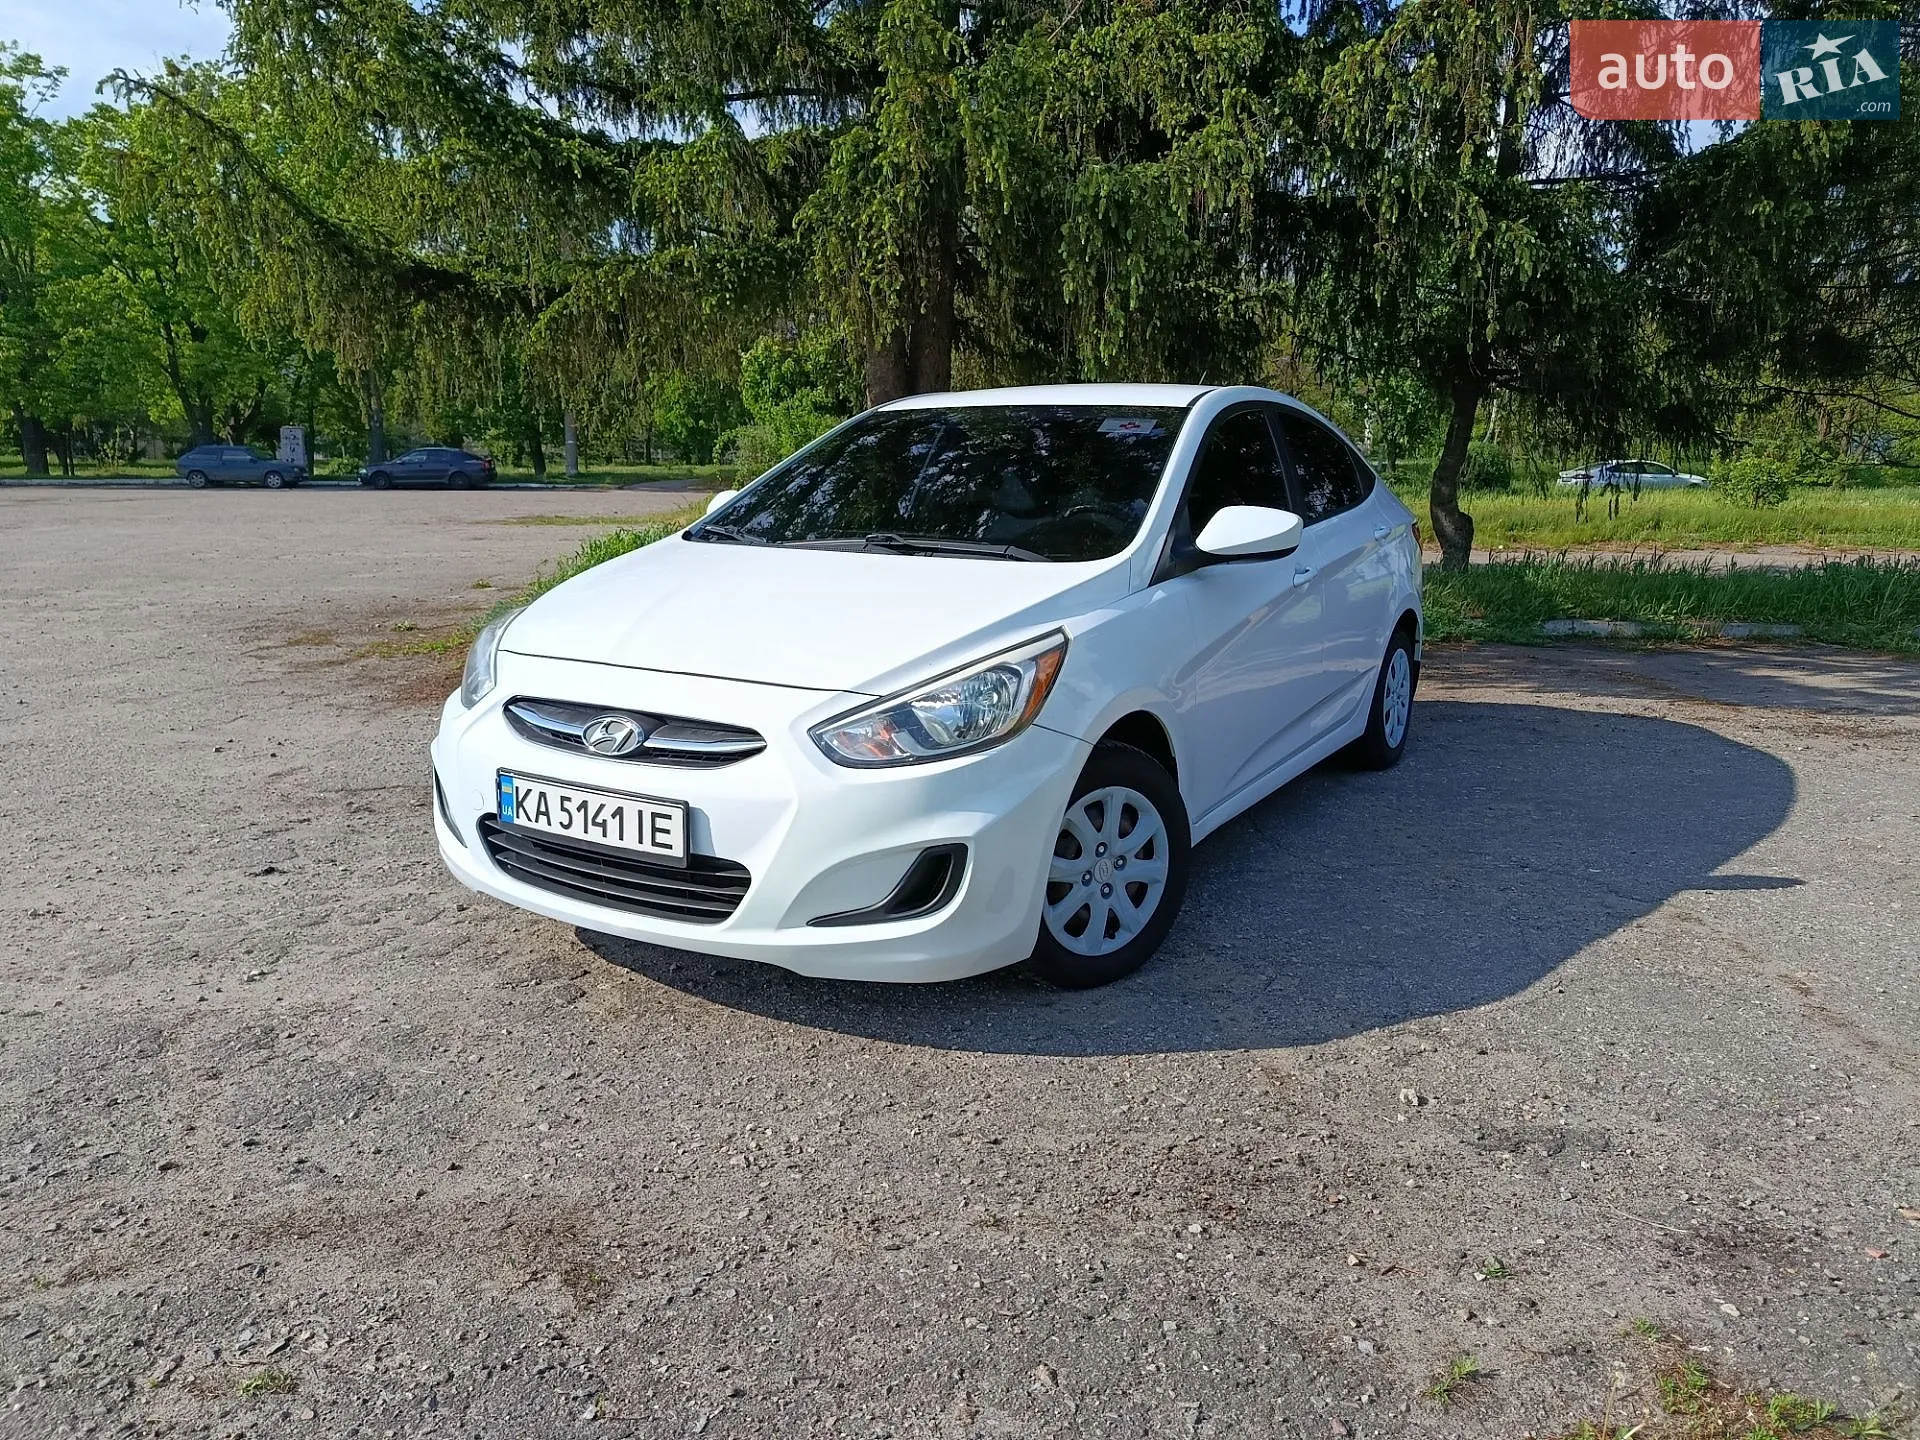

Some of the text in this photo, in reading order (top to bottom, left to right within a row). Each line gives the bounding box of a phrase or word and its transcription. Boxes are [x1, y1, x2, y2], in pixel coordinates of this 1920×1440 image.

[502, 804, 513, 817] UA
[515, 785, 673, 850] KA 5141 IE
